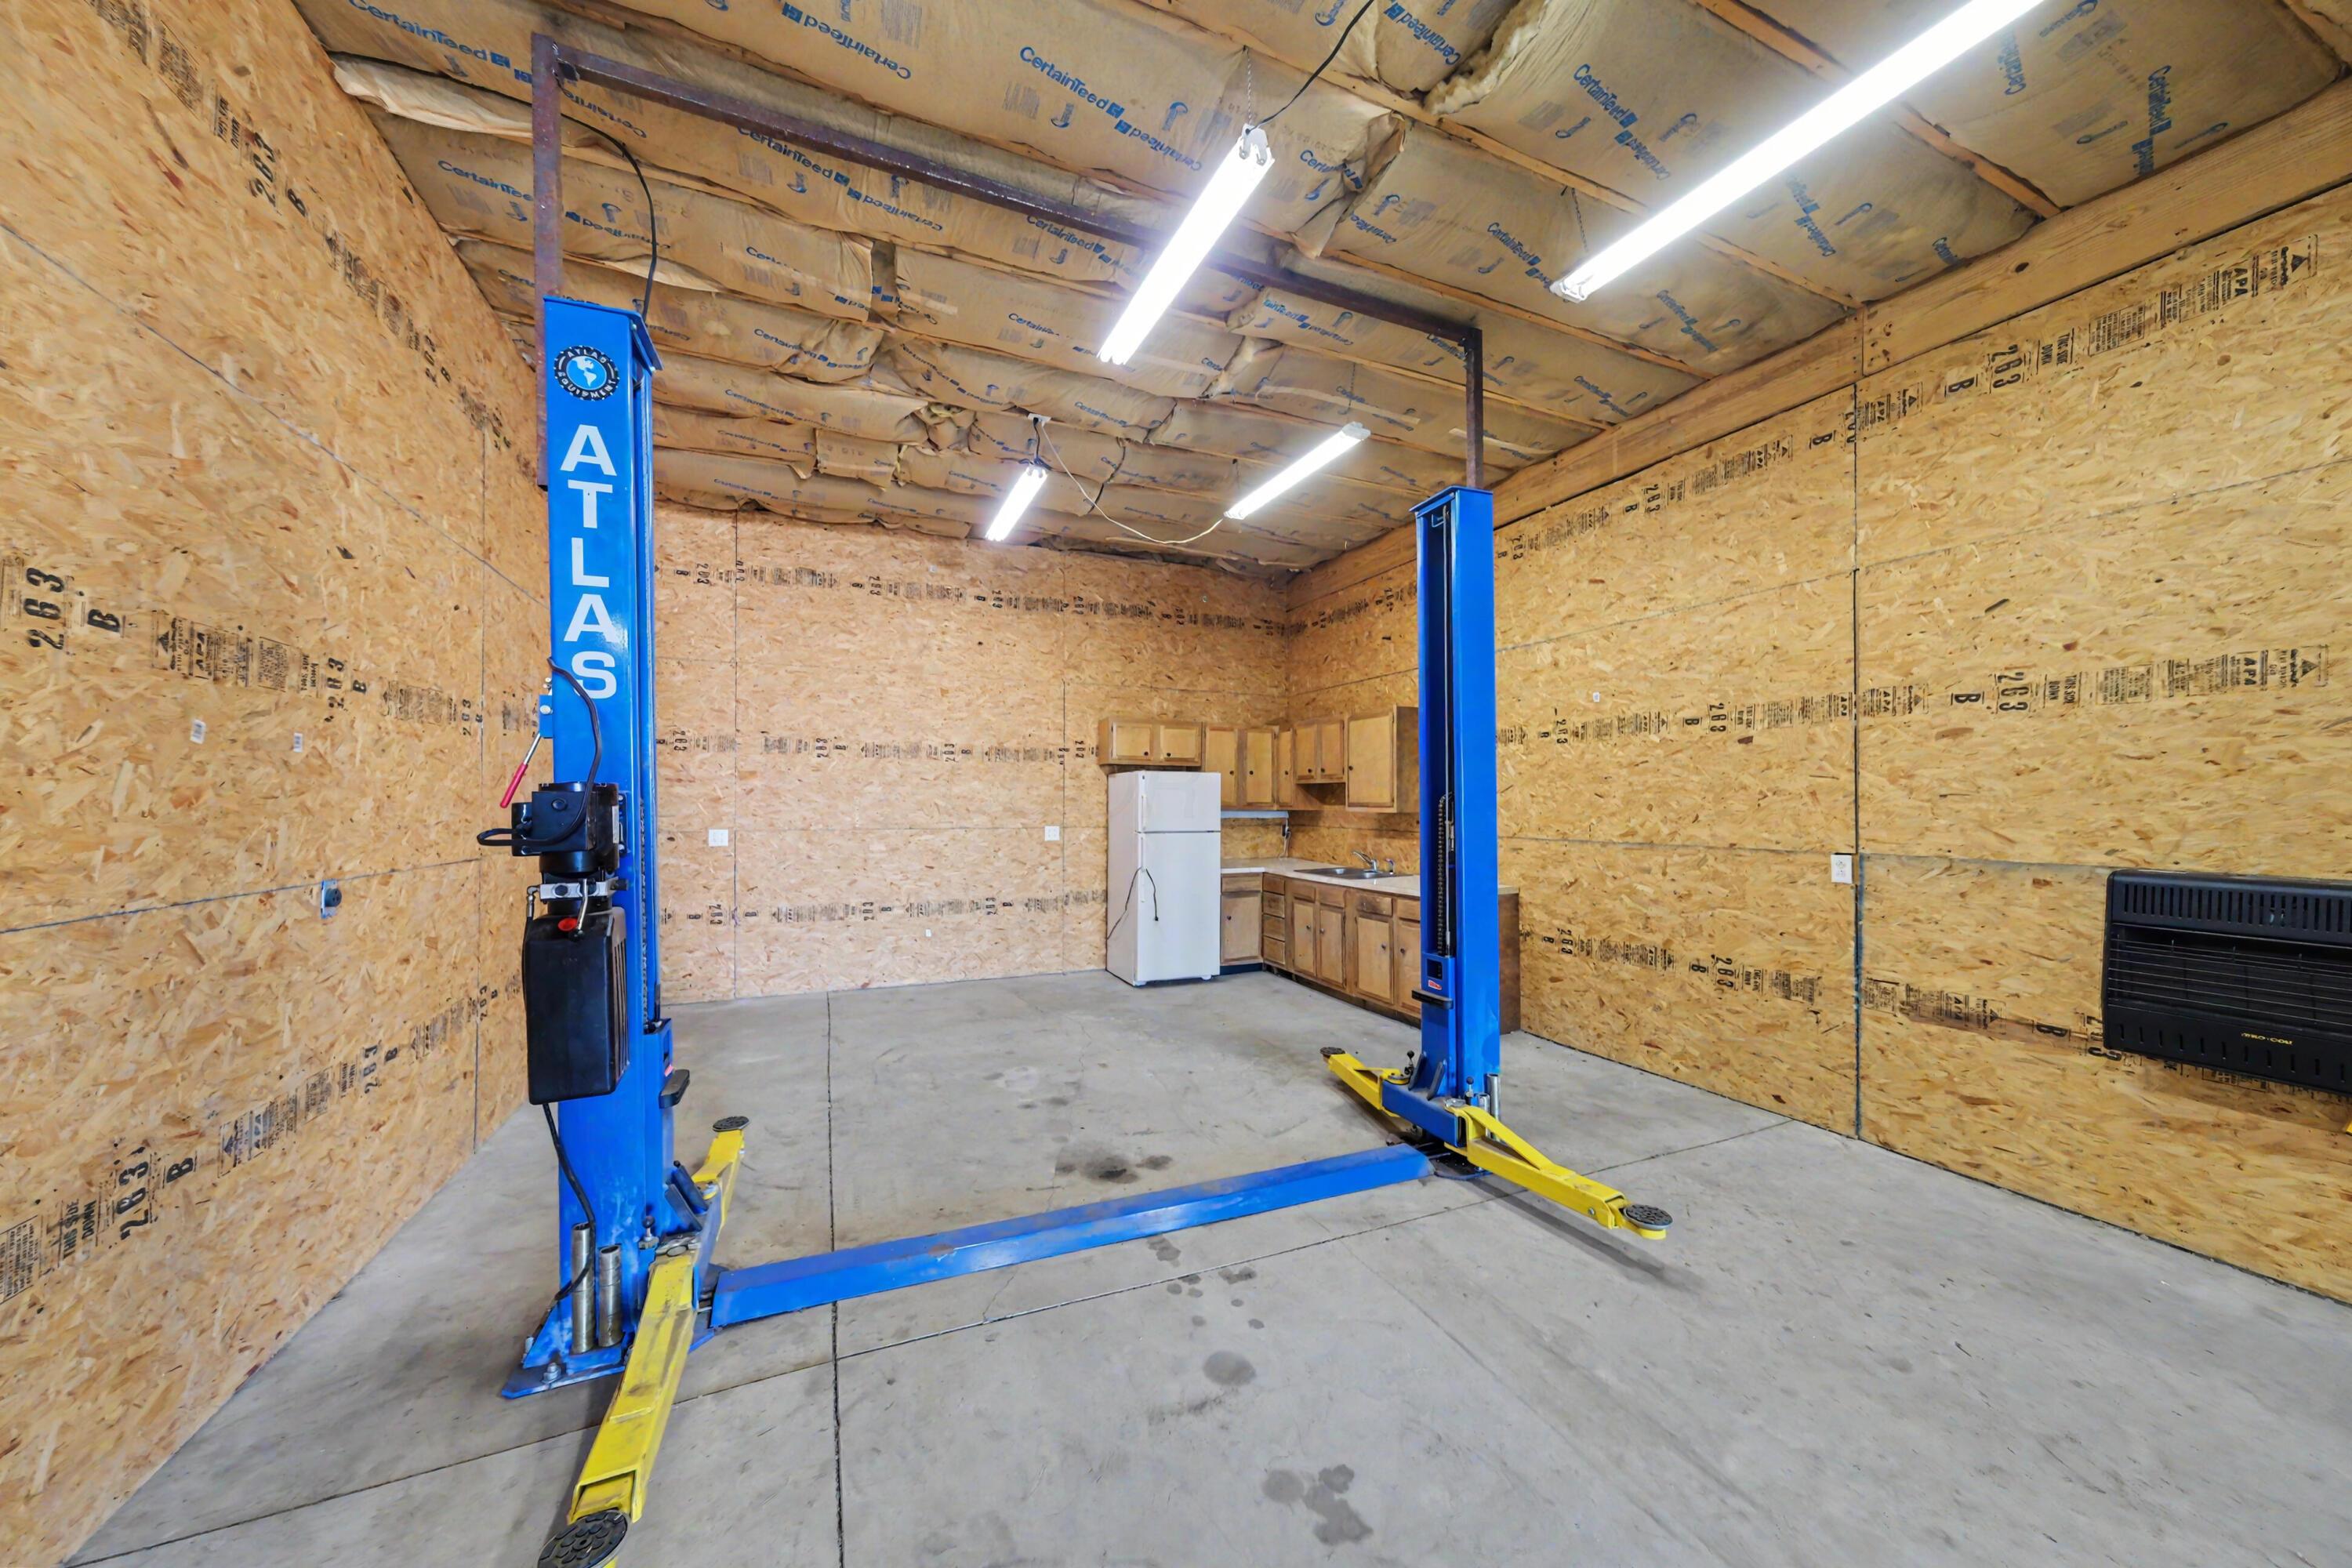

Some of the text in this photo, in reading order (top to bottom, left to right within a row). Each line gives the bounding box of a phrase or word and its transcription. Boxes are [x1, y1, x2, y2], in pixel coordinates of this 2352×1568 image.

[804, 15, 912, 79] CertainTeed
[1398, 13, 1461, 66] CertainTeed
[1019, 46, 1109, 111] CertainTeed
[2234, 267, 2249, 298] APA
[567, 348, 608, 364] ATLAS
[1991, 343, 2024, 390] 263
[2041, 343, 2053, 365] DOWN
[557, 371, 617, 399] EQUIPMENT
[1948, 376, 1975, 393] B
[1812, 432, 1834, 447] B
[1625, 503, 1637, 514] B
[560, 423, 620, 699] ATLAS
[24, 568, 66, 650] 263
[87, 608, 122, 634] B
[2243, 657, 2258, 687] APA
[352, 680, 368, 694] B
[1953, 692, 1981, 706] B
[1997, 671, 2029, 713] 263
[1683, 717, 1700, 727] B
[1544, 935, 1555, 945] B
[1691, 962, 1708, 975] B
[2038, 1025, 2069, 1038] B
[165, 1156, 197, 1184] B
[63, 1199, 79, 1259] THIS SIDE
[82, 1200, 96, 1241] DOWN
